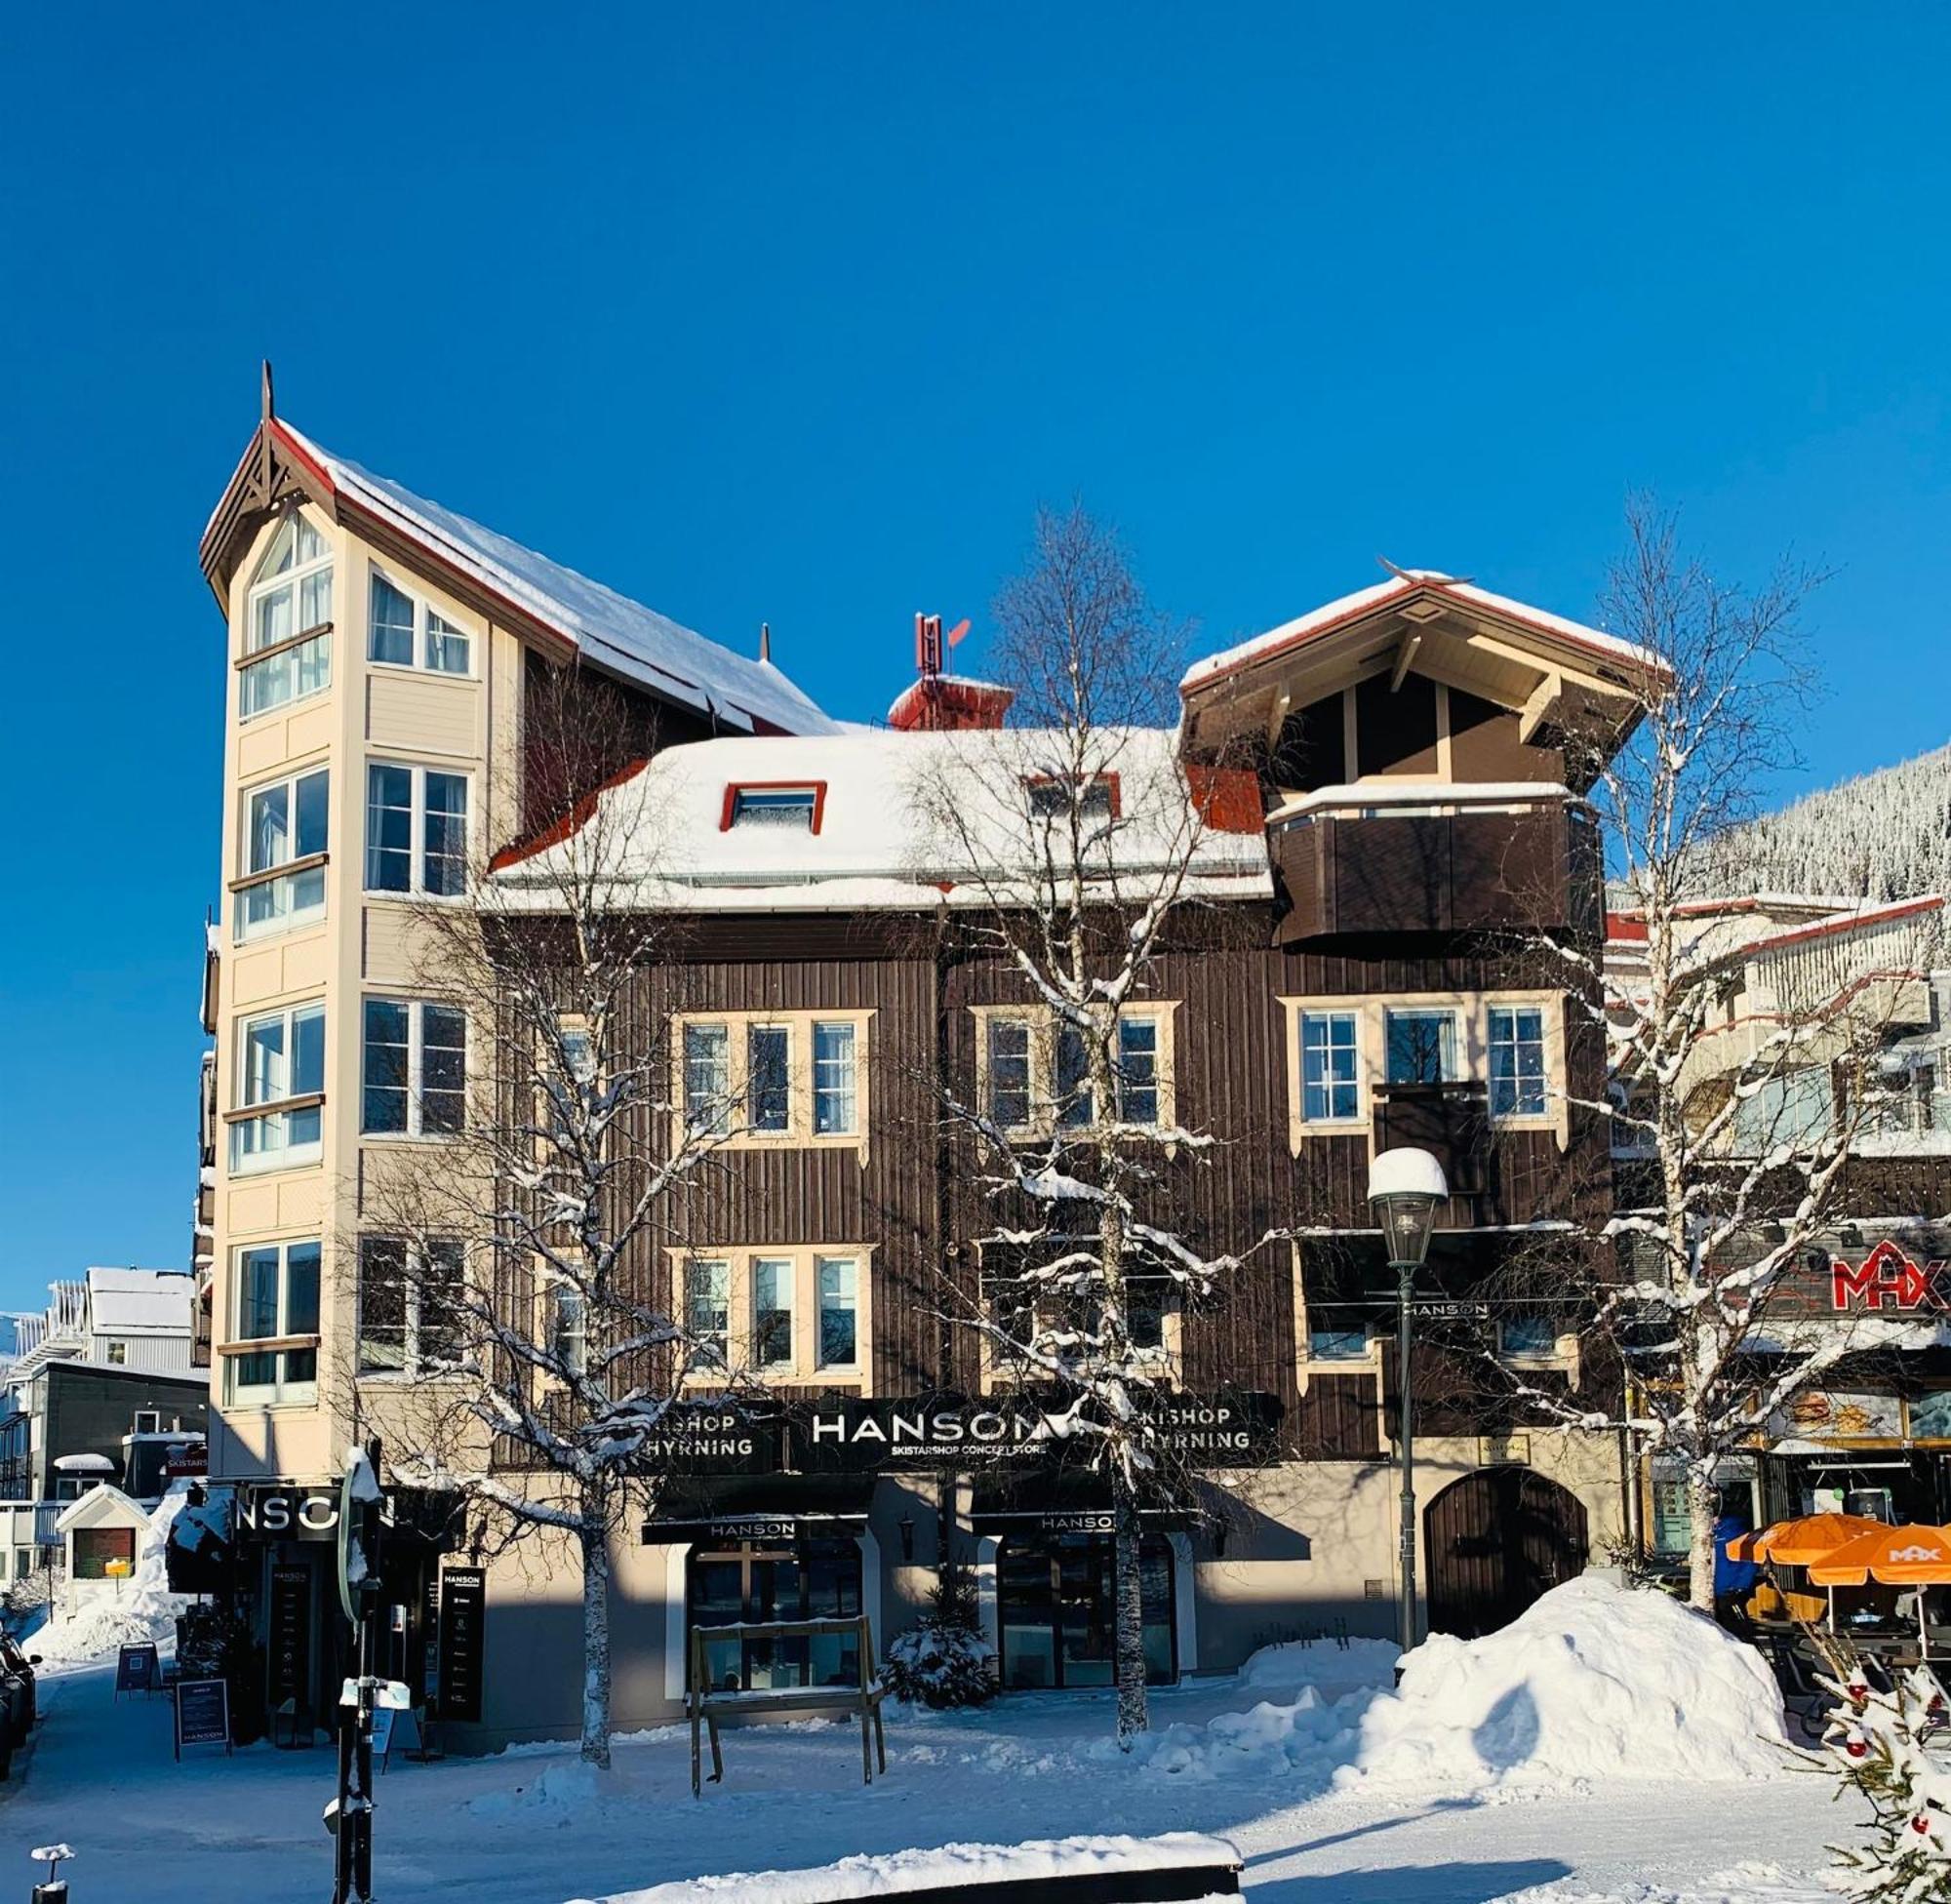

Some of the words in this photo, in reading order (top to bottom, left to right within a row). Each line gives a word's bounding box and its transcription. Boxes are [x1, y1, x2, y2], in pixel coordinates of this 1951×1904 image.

[1832, 1238, 1949, 1310] MAX
[1132, 1408, 1231, 1425] KISHOP
[646, 1440, 753, 1455] HYRNING
[891, 1446, 960, 1455] SKISTARSHOP
[710, 1523, 796, 1536] HANSON
[1041, 1517, 1116, 1529] HANSO
[1889, 1545, 1943, 1562] MAX
[444, 1575, 481, 1584] HANSON
